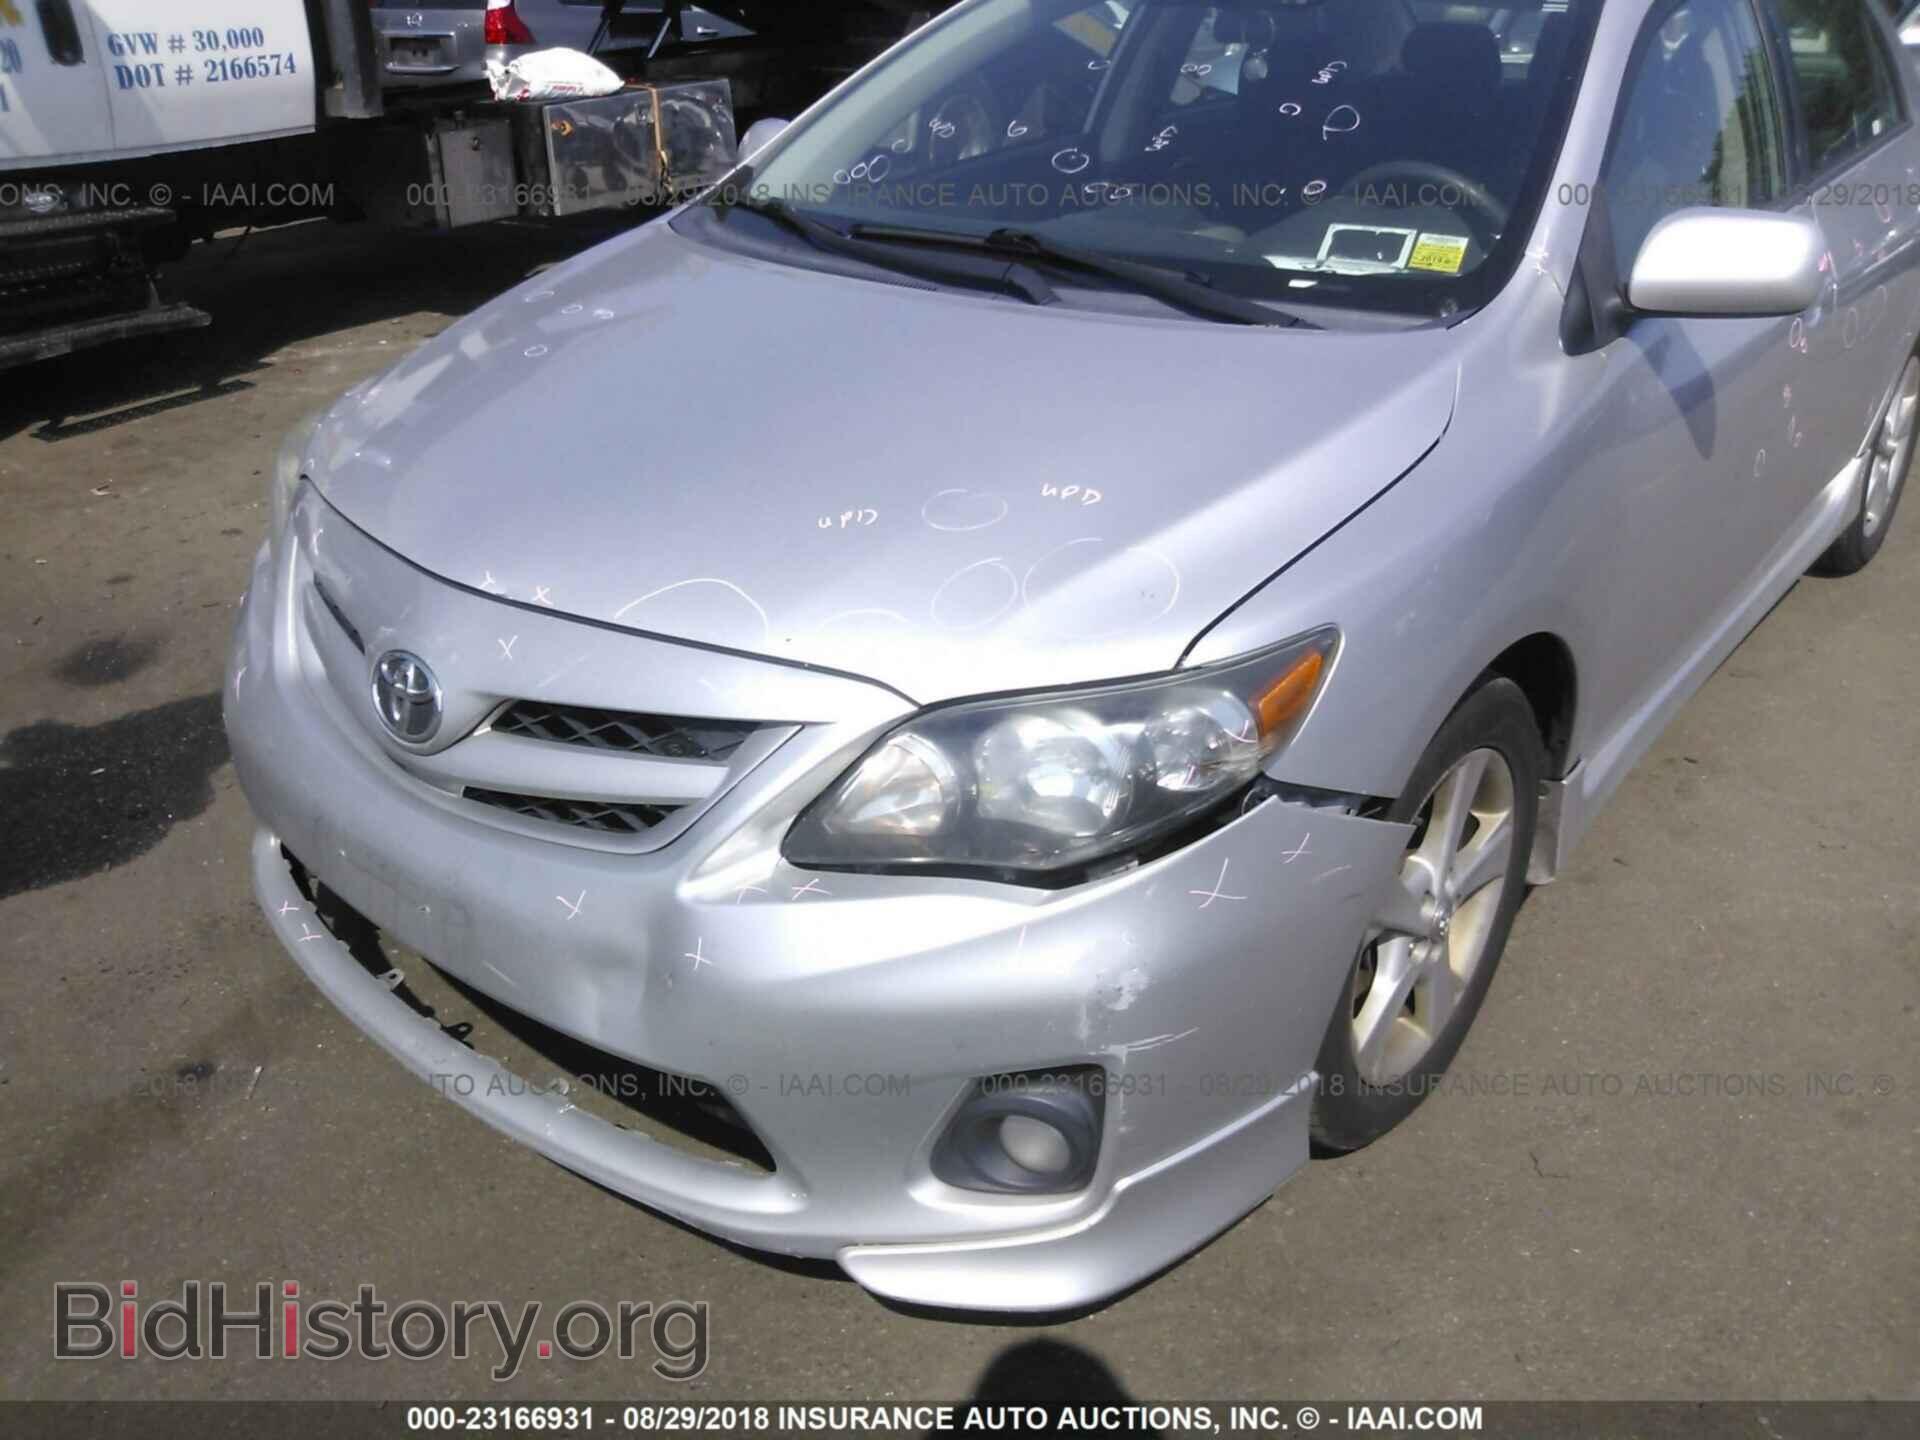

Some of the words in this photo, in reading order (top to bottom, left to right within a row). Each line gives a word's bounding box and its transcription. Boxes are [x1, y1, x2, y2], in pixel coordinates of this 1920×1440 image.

[107, 31, 158, 57] GVW
[168, 33, 186, 52] #
[193, 27, 265, 53] 30,000
[115, 62, 166, 91] DOT
[176, 65, 194, 86] #
[204, 52, 297, 83] 2166574
